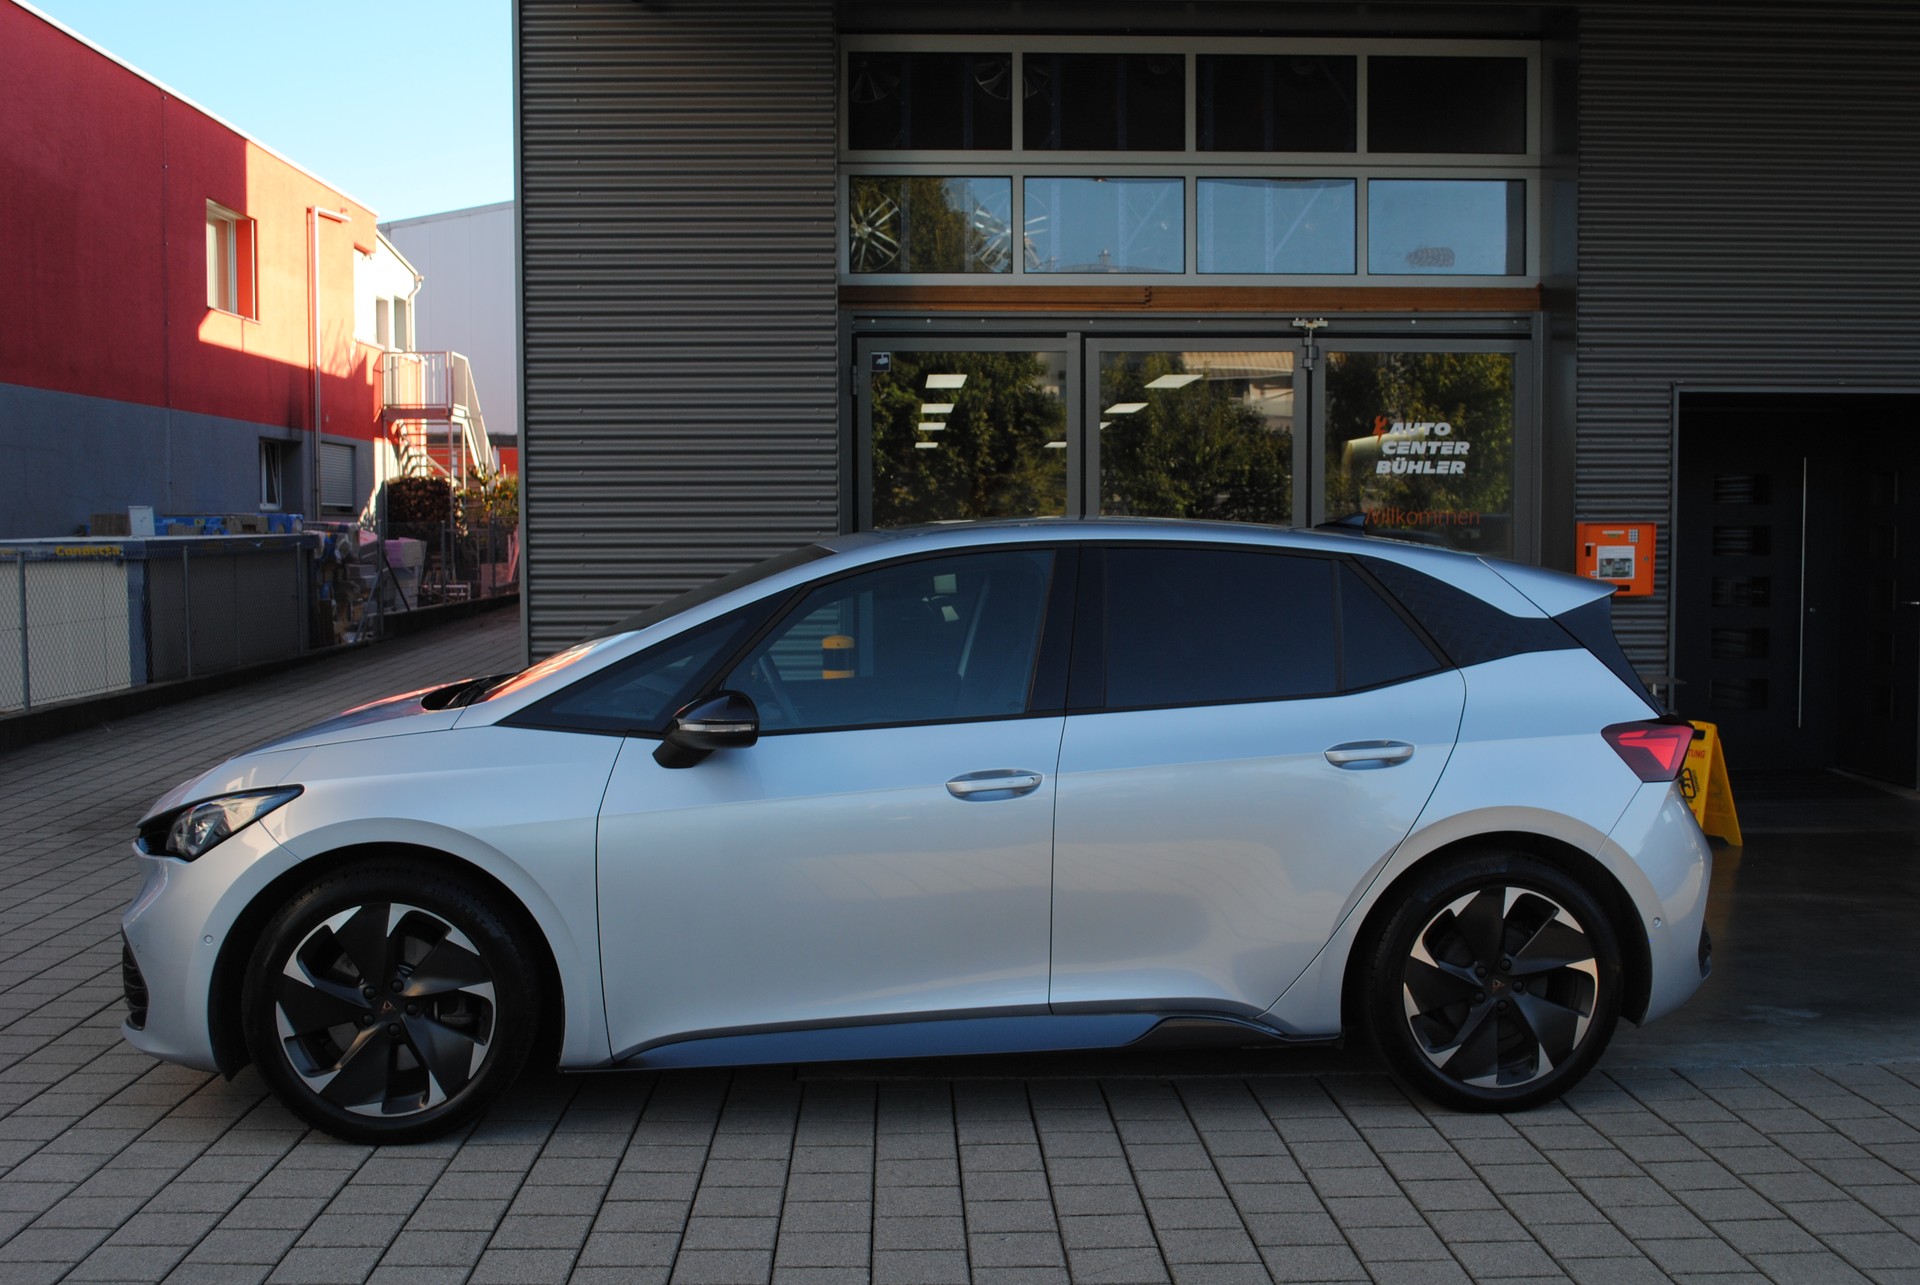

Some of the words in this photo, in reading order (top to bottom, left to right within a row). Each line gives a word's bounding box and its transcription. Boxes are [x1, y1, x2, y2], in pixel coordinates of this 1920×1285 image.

[1389, 422, 1451, 436] AUTO
[1382, 441, 1470, 455] CENTER
[1375, 457, 1466, 474] BÜHLER
[1362, 505, 1480, 525] Willkommen
[1688, 749, 1705, 758] TUNG
